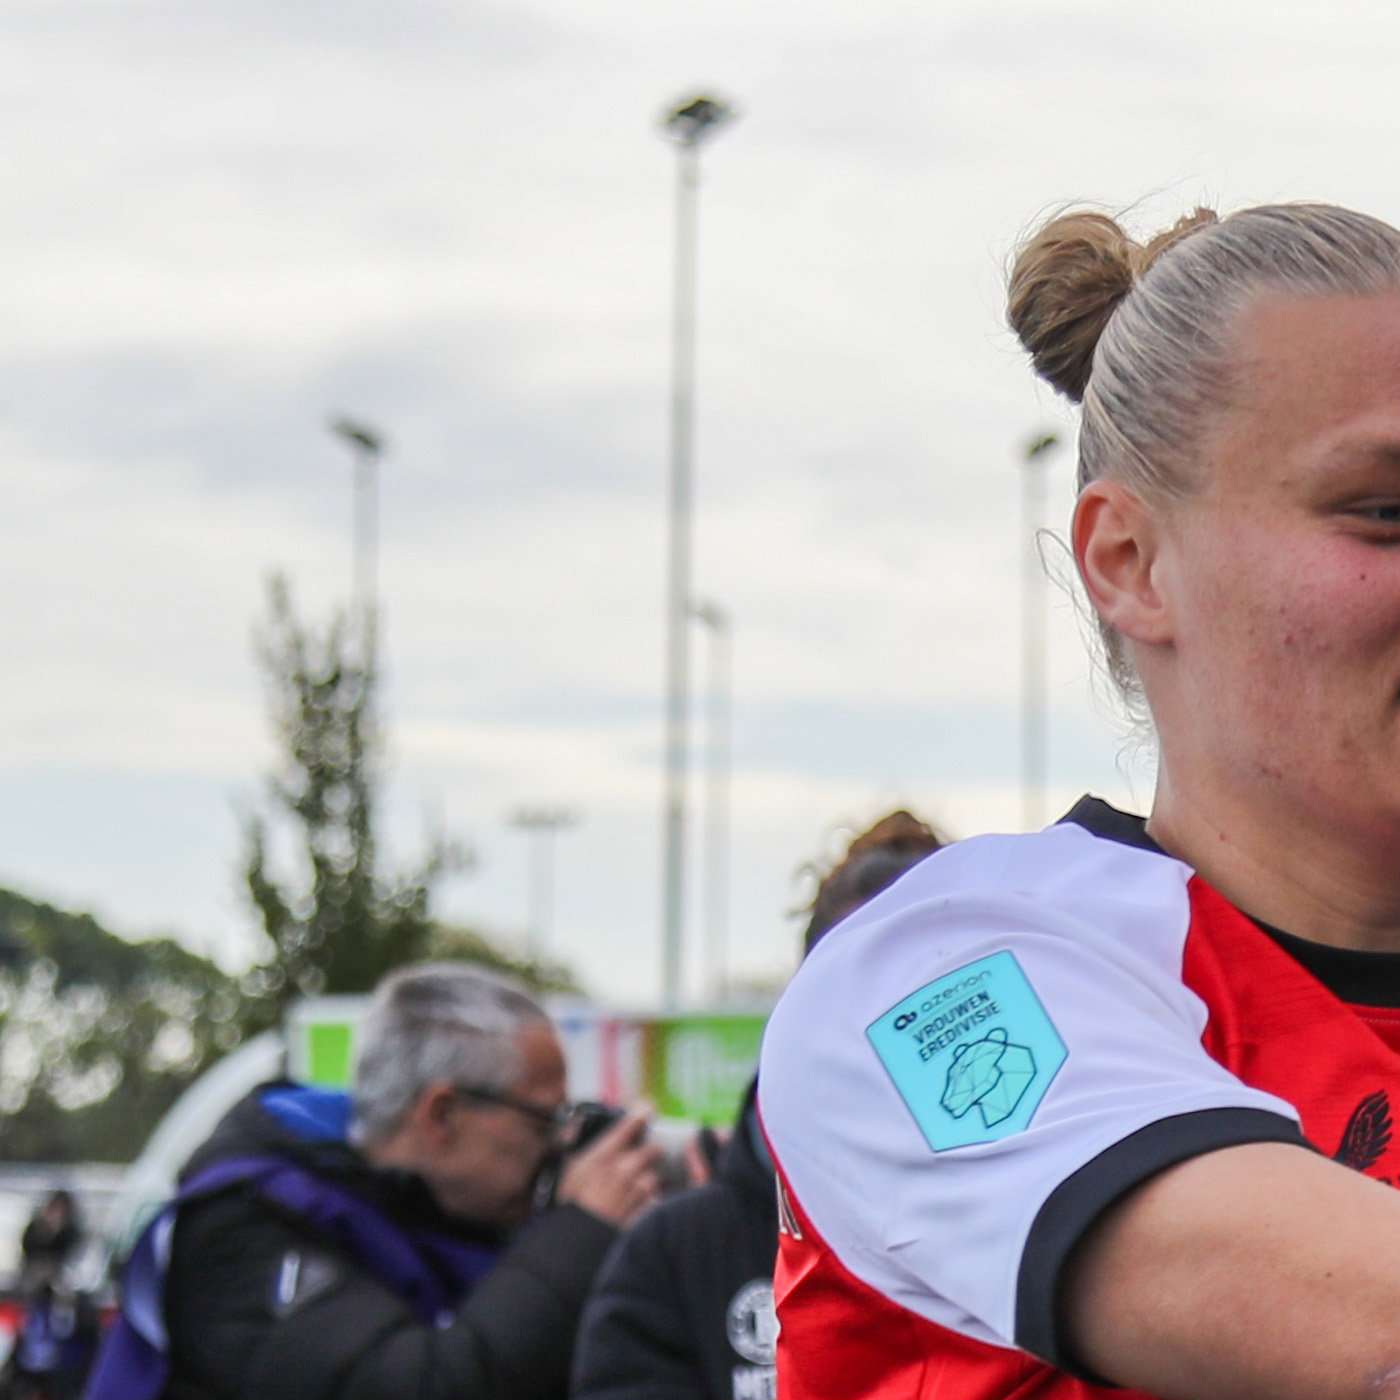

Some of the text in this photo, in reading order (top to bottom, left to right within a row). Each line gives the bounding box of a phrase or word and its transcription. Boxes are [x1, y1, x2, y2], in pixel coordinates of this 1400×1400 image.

[911, 989, 991, 1046] VROUWEN
[921, 970, 992, 1013] azerion
[917, 1001, 1000, 1063] EREDIVISIE
